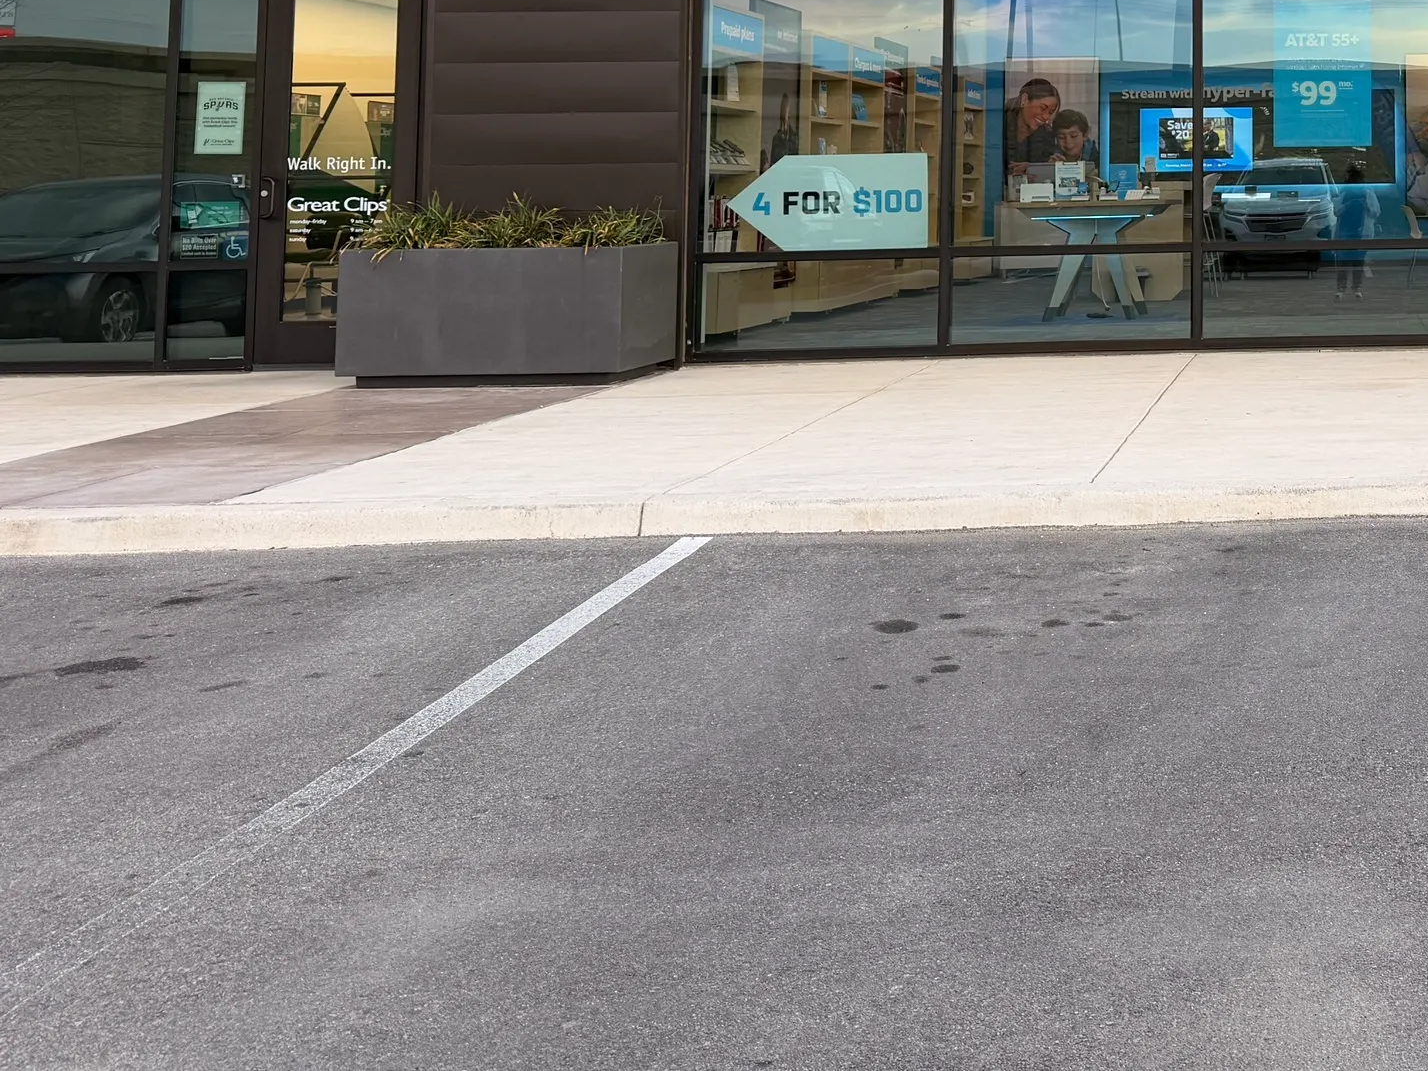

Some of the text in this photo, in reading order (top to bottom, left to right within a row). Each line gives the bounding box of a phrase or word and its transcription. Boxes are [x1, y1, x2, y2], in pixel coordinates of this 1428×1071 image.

[721, 21, 755, 43] Prepaid plans
[1285, 33, 1360, 47] AT&T 55+
[1121, 89, 1166, 99] Stream
[1291, 80, 1337, 106] $99
[203, 100, 239, 111] SPURS
[1167, 120, 1193, 130] Save
[287, 157, 392, 173] Walk Right In.
[287, 197, 388, 215] Great Clips
[752, 186, 922, 217] 4 FOR $100
